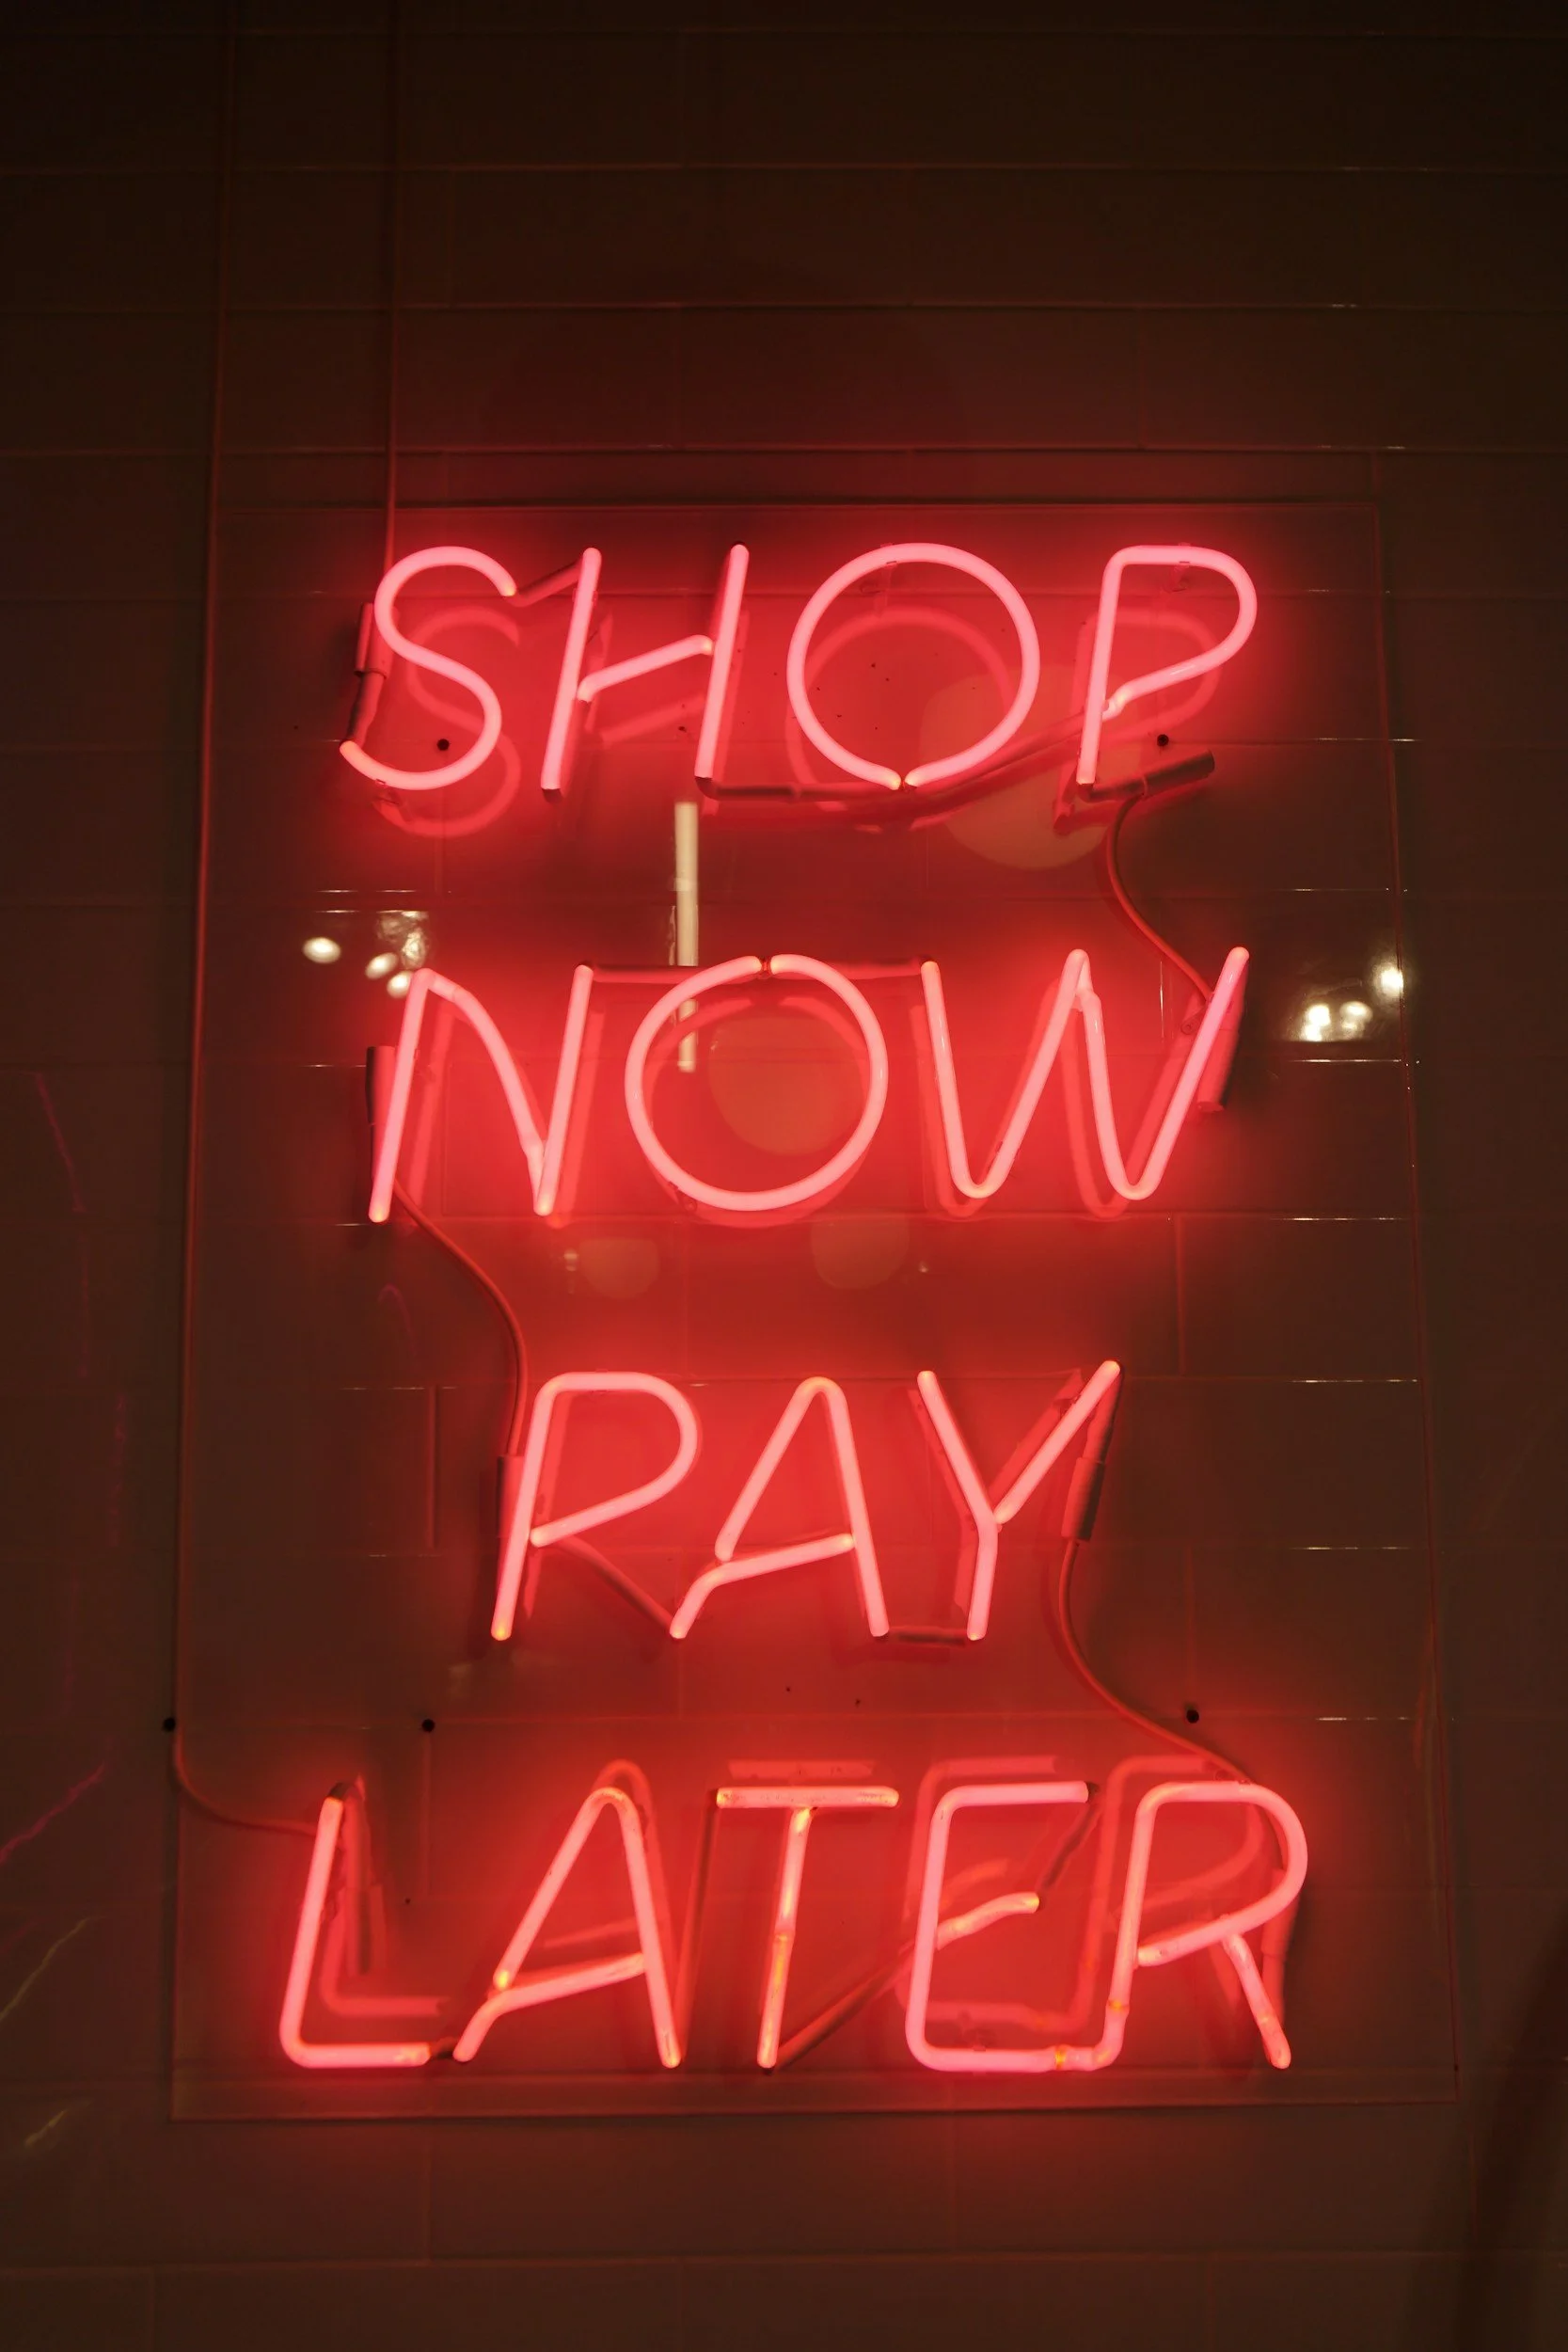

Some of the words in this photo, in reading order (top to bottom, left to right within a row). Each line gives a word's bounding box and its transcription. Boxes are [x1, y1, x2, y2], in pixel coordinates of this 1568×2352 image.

[339, 540, 1260, 792] SHOP
[367, 944, 1251, 1225] NOW
[491, 1358, 1121, 1642] PAY
[278, 1776, 1311, 2072] LATER
